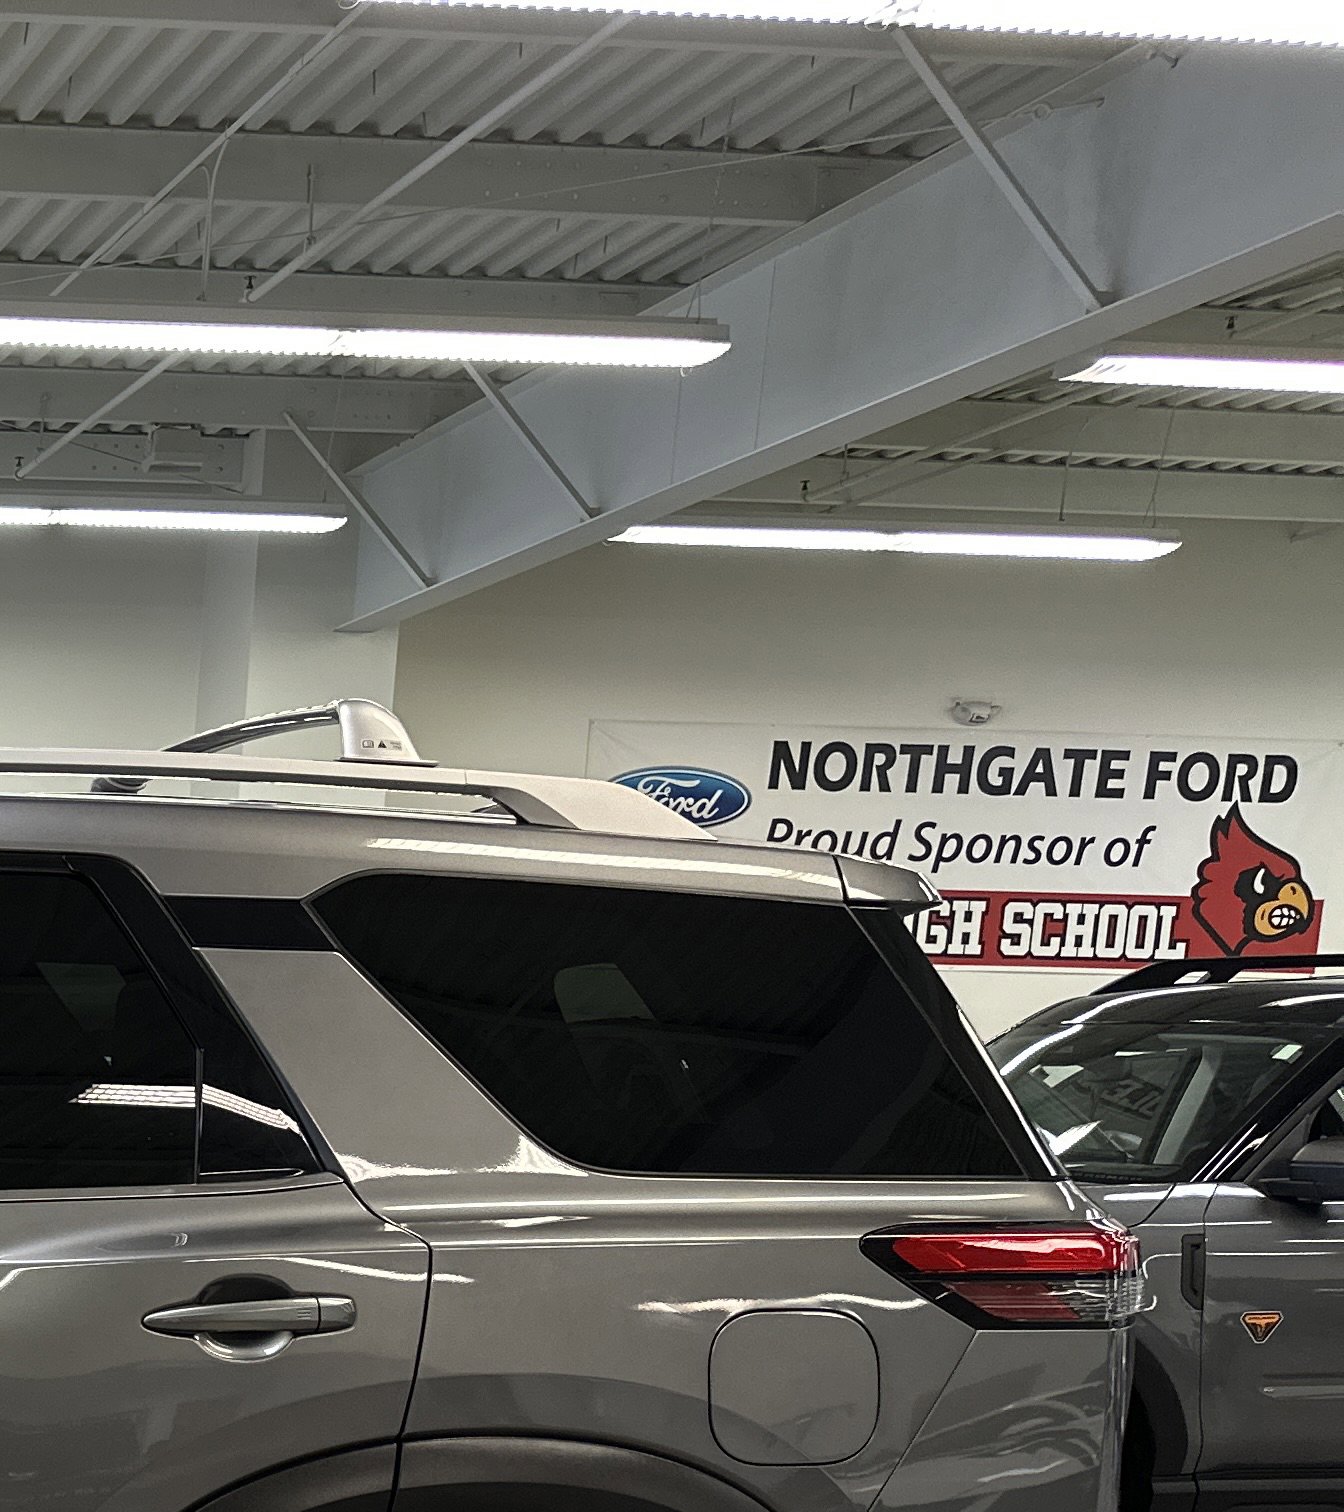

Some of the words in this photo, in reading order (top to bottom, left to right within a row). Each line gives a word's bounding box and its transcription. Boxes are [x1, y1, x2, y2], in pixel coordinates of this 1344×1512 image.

[767, 740, 1131, 799] NORTHGATE
[1142, 750, 1299, 804] FORD
[766, 818, 903, 861] Proud
[907, 821, 1097, 874] Sponsor
[1102, 825, 1157, 868] of
[999, 901, 1187, 960] SCHOOL
